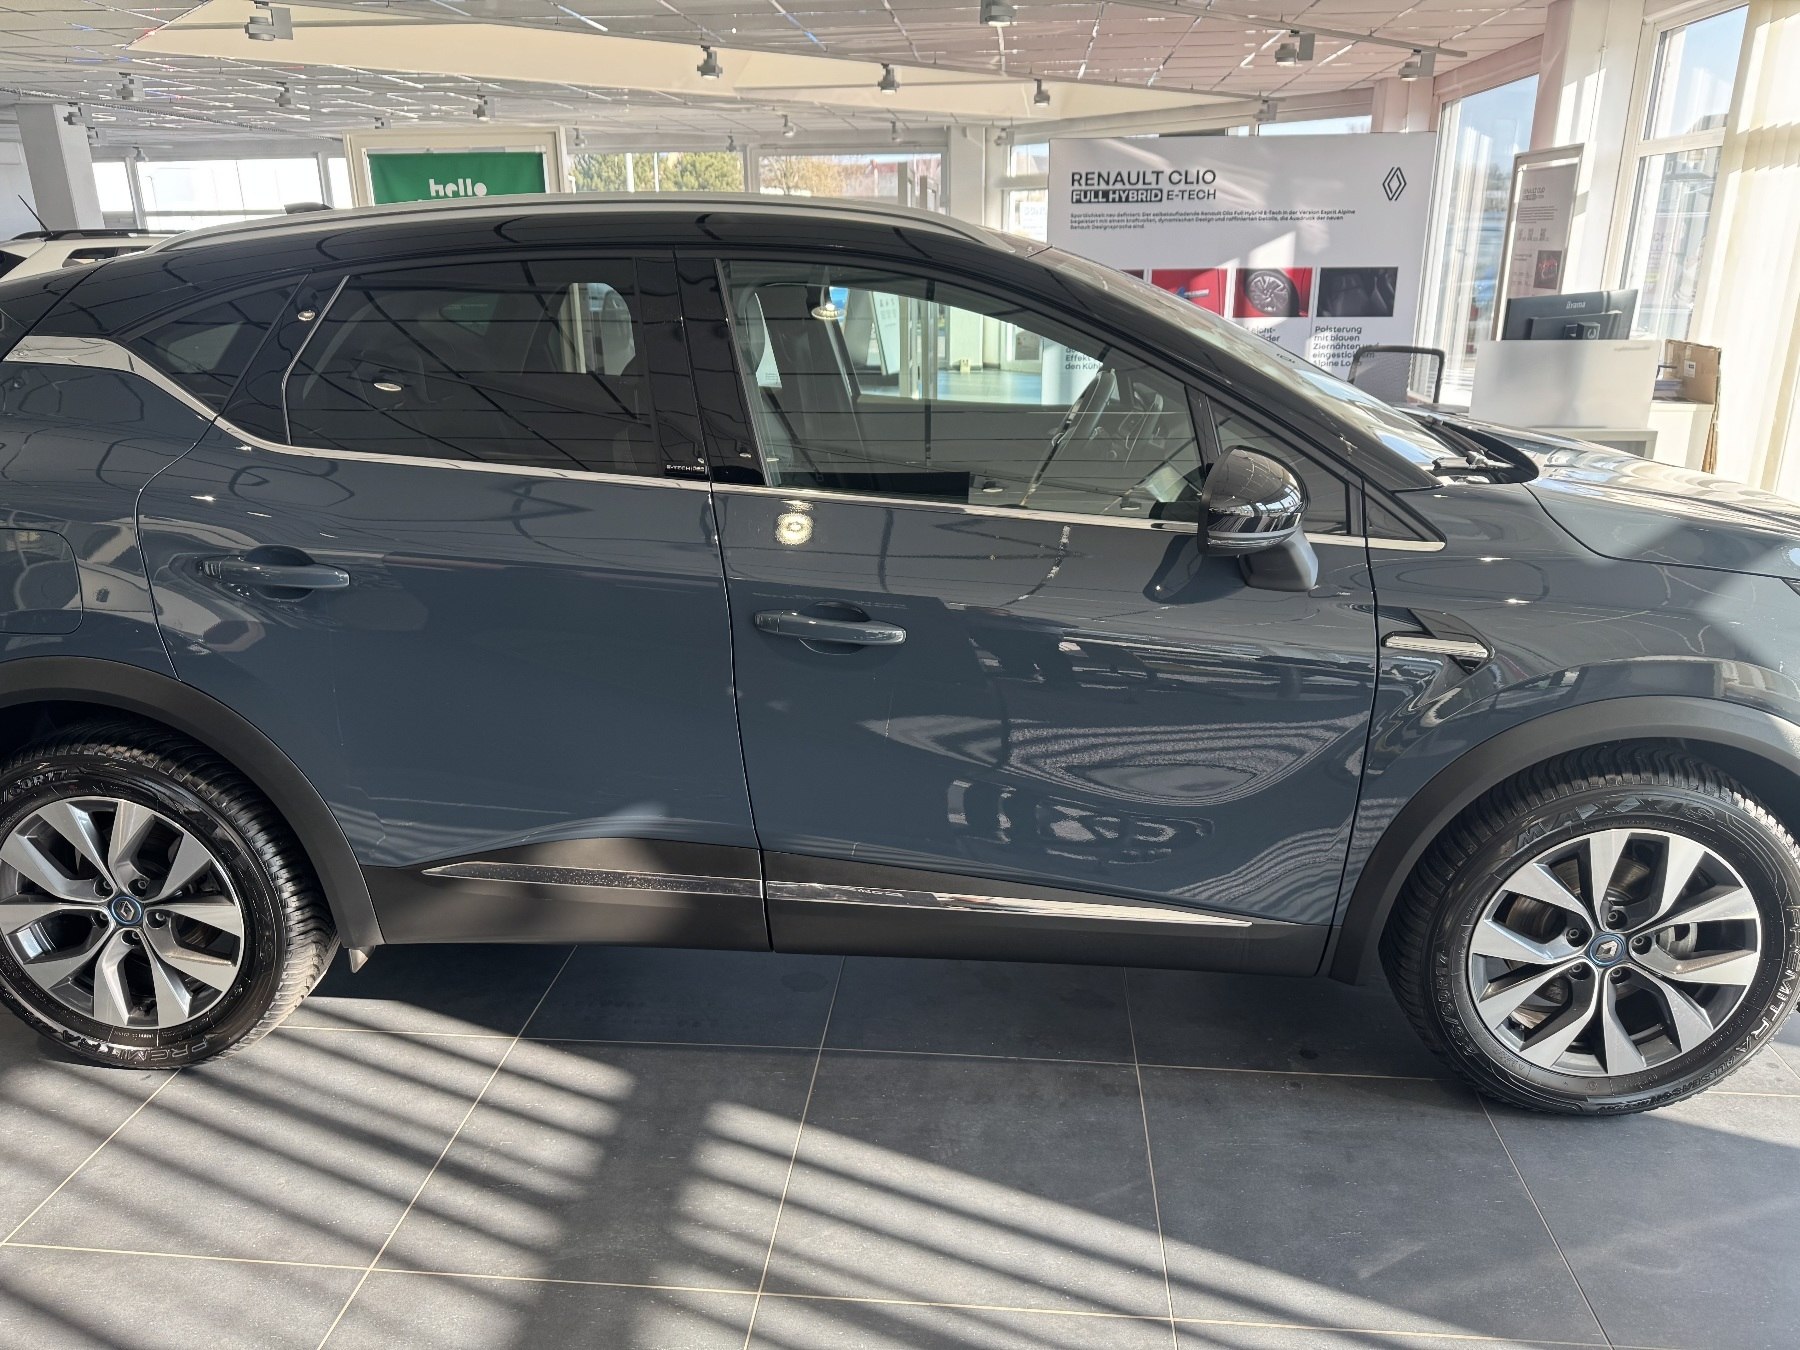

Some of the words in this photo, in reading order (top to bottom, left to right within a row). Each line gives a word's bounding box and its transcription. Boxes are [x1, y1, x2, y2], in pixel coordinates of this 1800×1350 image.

[1071, 170, 1164, 187] RENAULT
[1168, 169, 1216, 185] CLIO
[428, 178, 487, 197] hello
[1072, 189, 1107, 203] FULL
[1108, 188, 1162, 203] HYBRID
[1166, 188, 1217, 201] E-TECH
[1314, 325, 1362, 335] Polsterung
[1313, 334, 1329, 342] mit
[1329, 333, 1360, 342] blauen
[1312, 341, 1360, 350] Ziernähten
[1065, 362, 1081, 370] den
